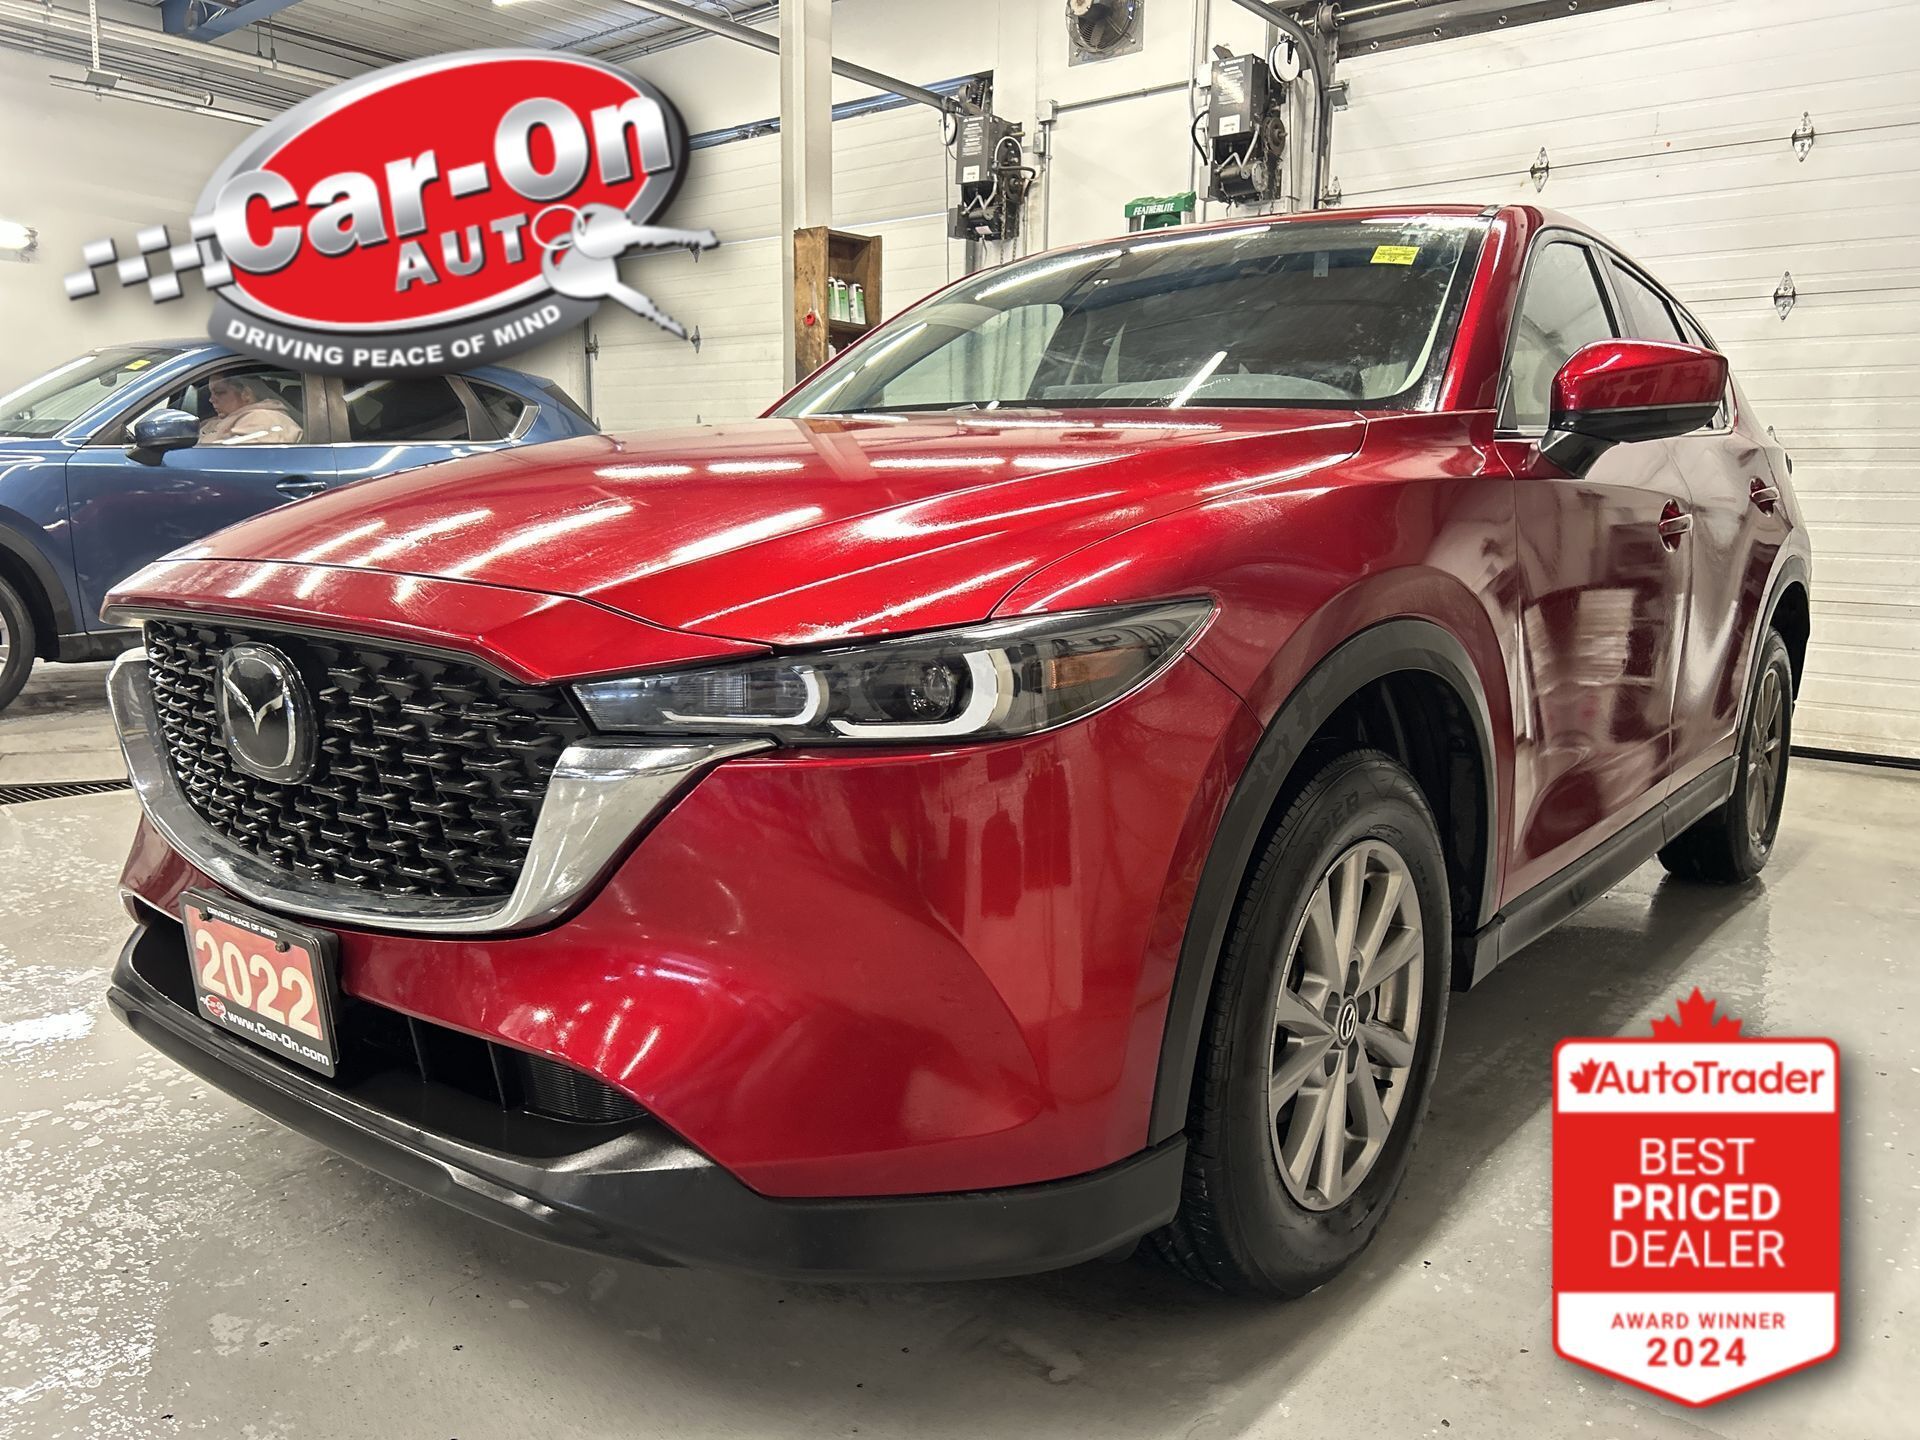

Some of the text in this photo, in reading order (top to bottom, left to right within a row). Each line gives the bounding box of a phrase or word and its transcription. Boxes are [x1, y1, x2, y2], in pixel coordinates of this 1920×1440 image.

[1133, 202, 1175, 216] FEATHERLITE
[196, 928, 319, 1040] 2022
[227, 1011, 330, 1066] www.Car-On.com
